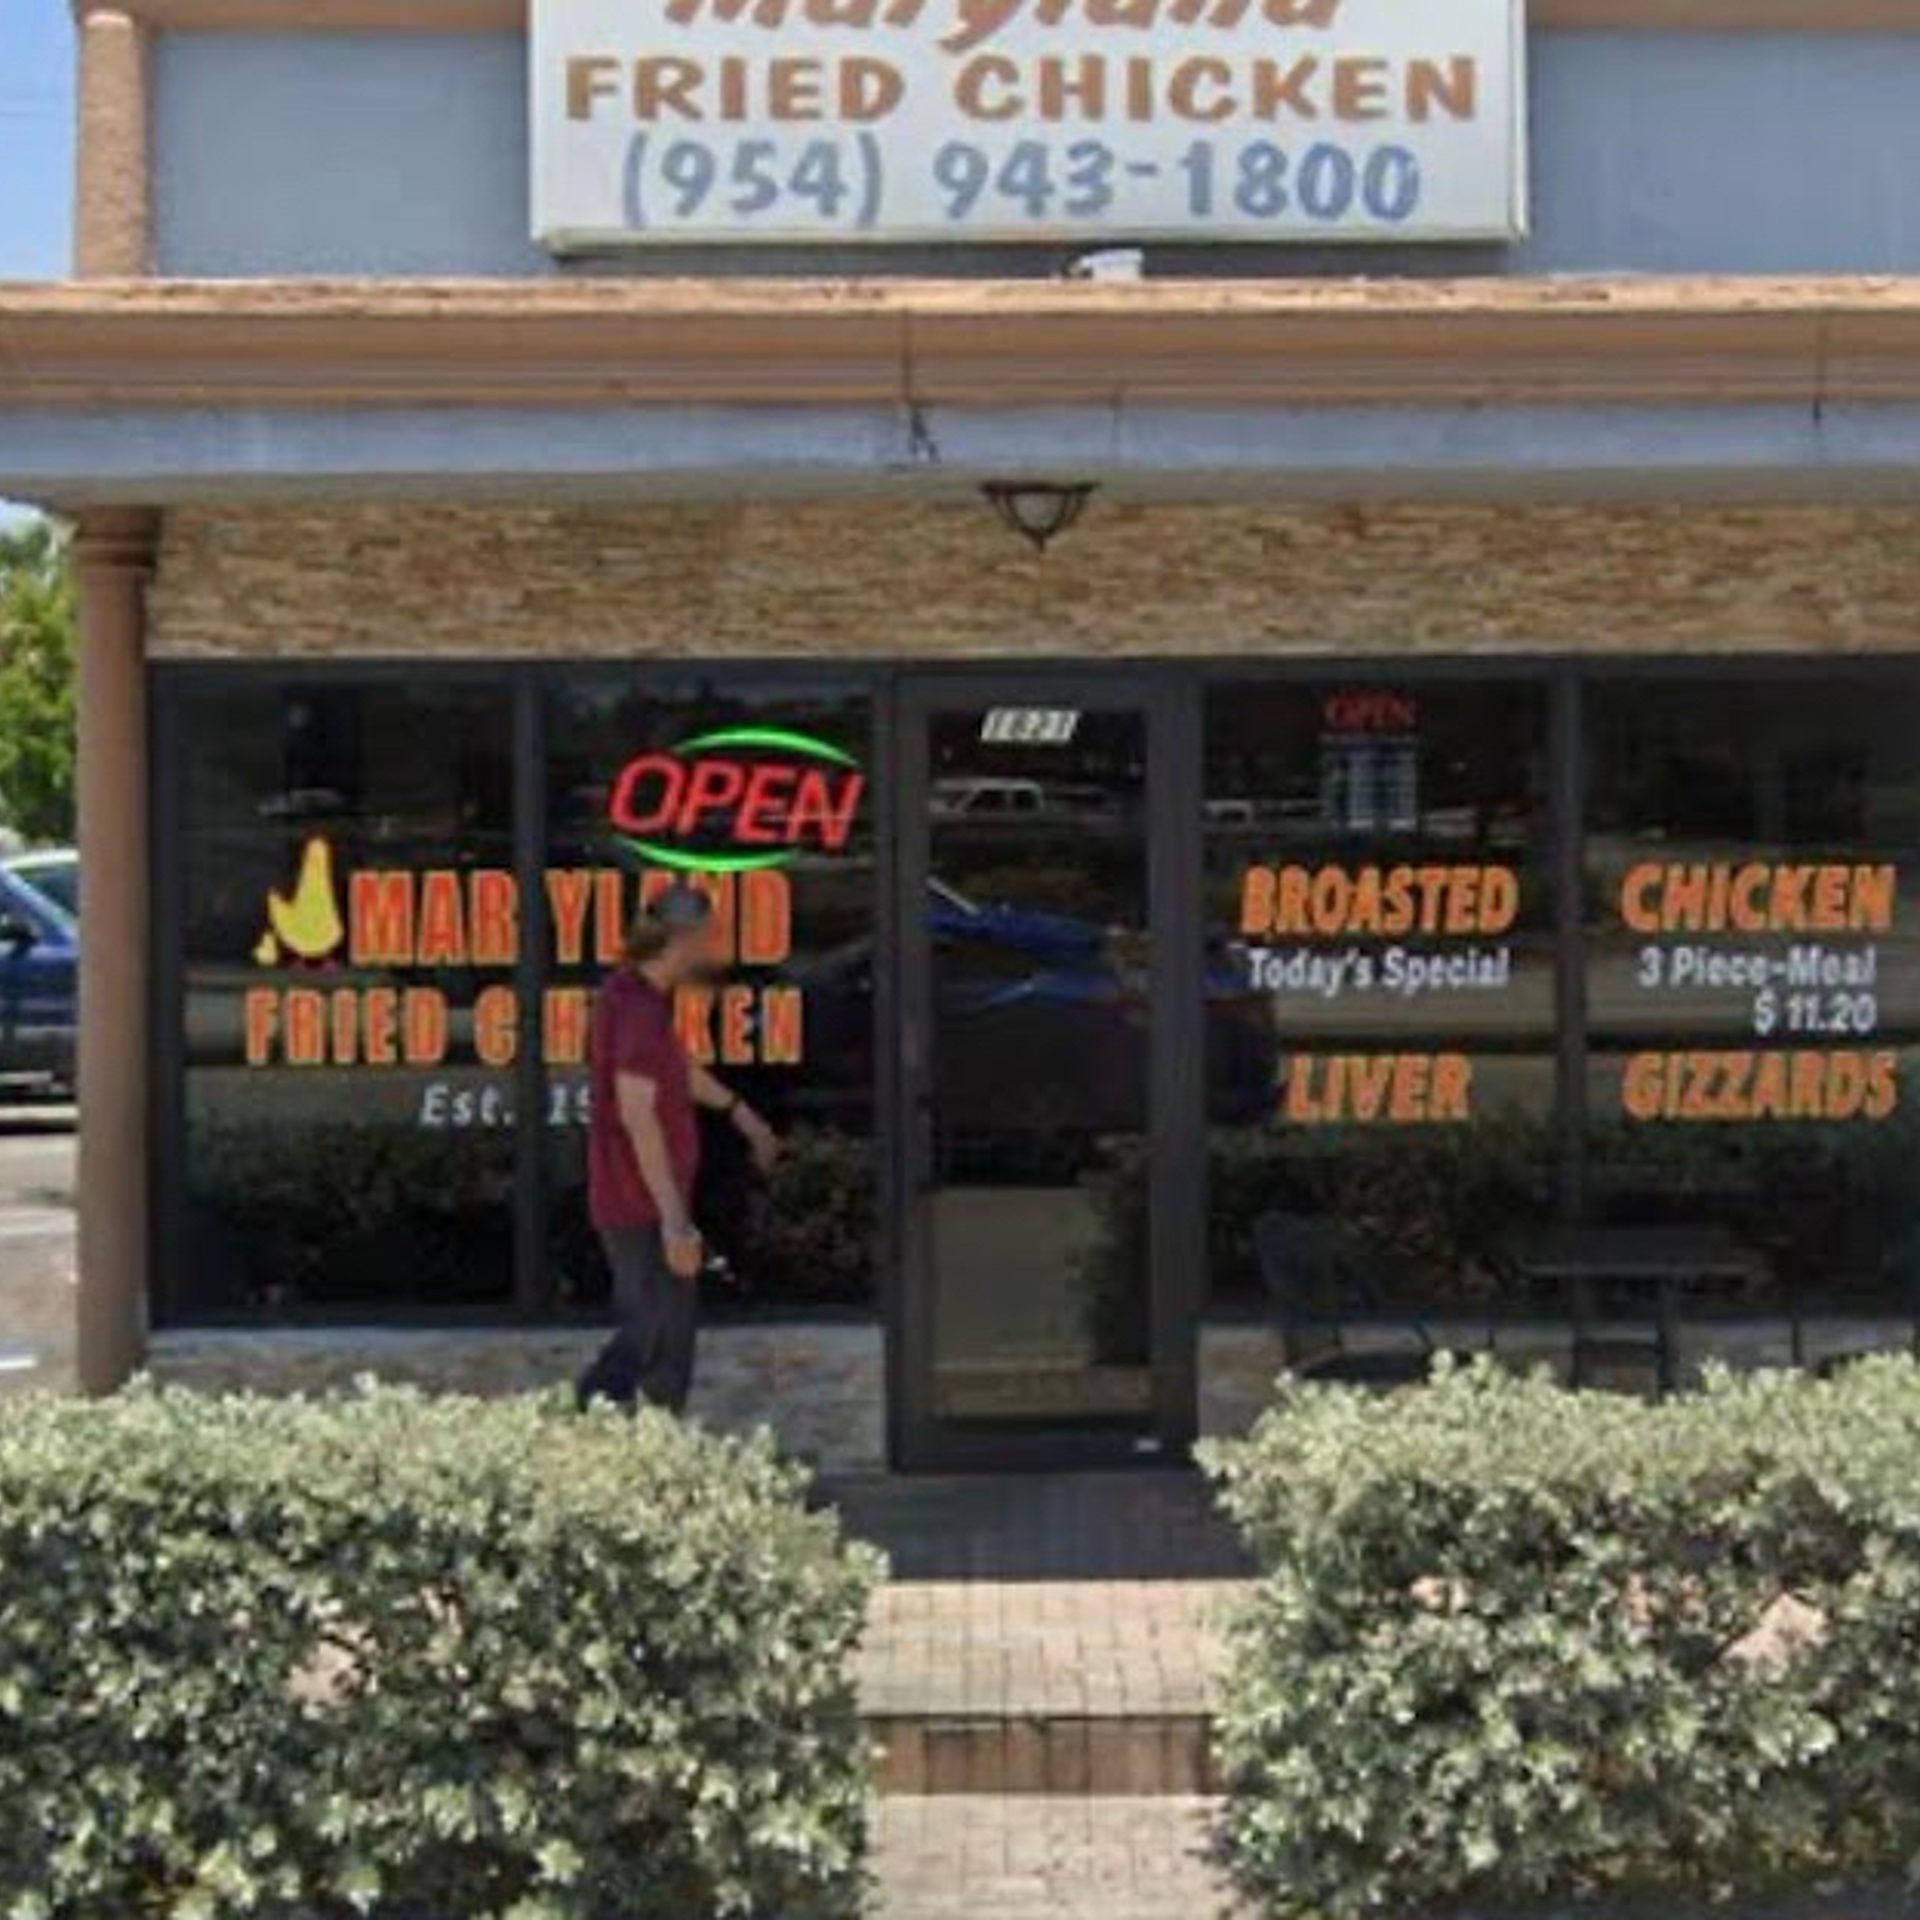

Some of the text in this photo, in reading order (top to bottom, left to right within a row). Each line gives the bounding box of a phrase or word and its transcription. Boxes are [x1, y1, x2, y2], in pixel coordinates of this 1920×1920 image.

[565, 54, 1477, 123] FRIED CHICKEN
[622, 132, 1420, 228] (954) 943-1800
[609, 752, 865, 848] OPEN
[1241, 864, 1896, 935] BROASTED CHICKEN
[1247, 947, 1511, 998] Today's Special
[1638, 946, 1662, 987] 3
[244, 988, 448, 1066] FRIED
[1754, 991, 1877, 1036] $ 11.20
[418, 1084, 517, 1126] Est.
[1285, 1053, 1896, 1121] LIVER GIZZARDS
